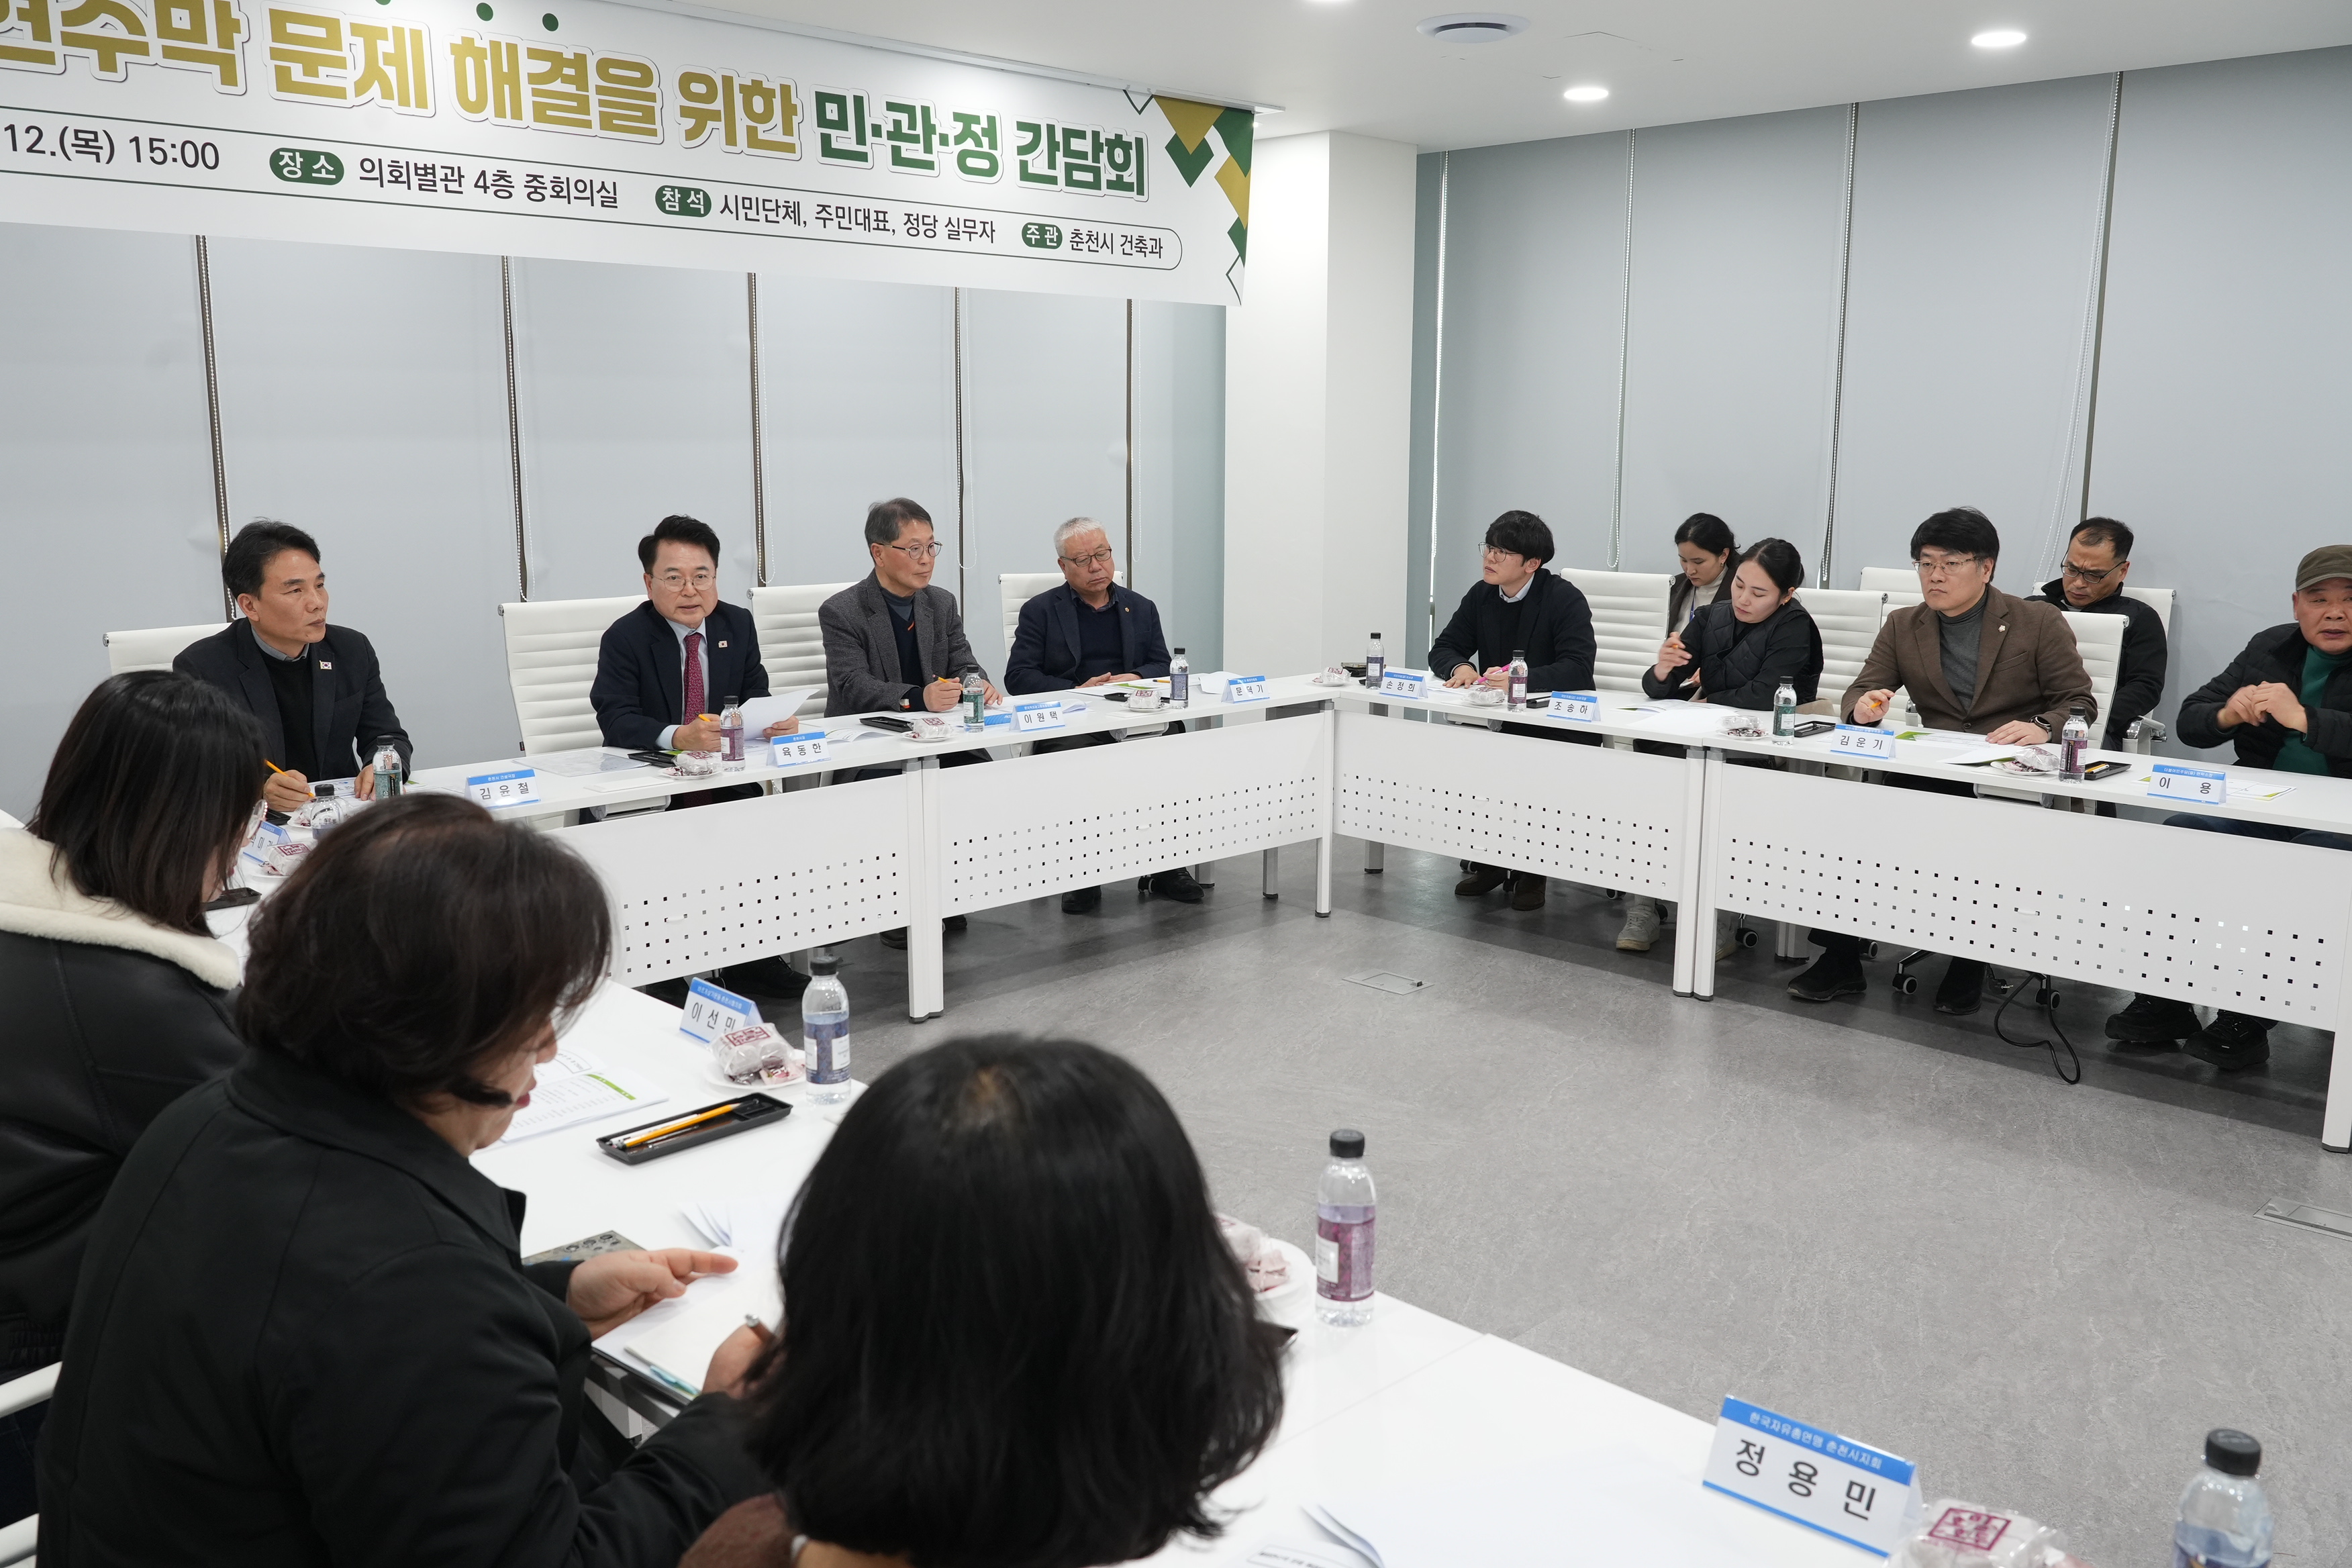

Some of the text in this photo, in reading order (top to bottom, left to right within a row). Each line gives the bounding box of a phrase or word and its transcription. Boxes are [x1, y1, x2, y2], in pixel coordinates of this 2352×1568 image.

[269, 10, 428, 109] 문제
[451, 37, 658, 138] 해결을
[677, 72, 798, 154] 위한
[1015, 121, 1145, 195] 간담회
[4, 124, 115, 164] 12.(목)
[129, 136, 219, 170] 15:00
[359, 158, 464, 195] 의회별관
[474, 169, 515, 199] 4층
[524, 174, 618, 209] 중회의실
[720, 195, 807, 228] 시민단체,
[814, 203, 895, 236] 주민대표,
[903, 213, 938, 238] 정당
[944, 217, 995, 244] 실무자
[1069, 228, 1114, 255] 춘천시
[1119, 234, 1164, 259] 건축과
